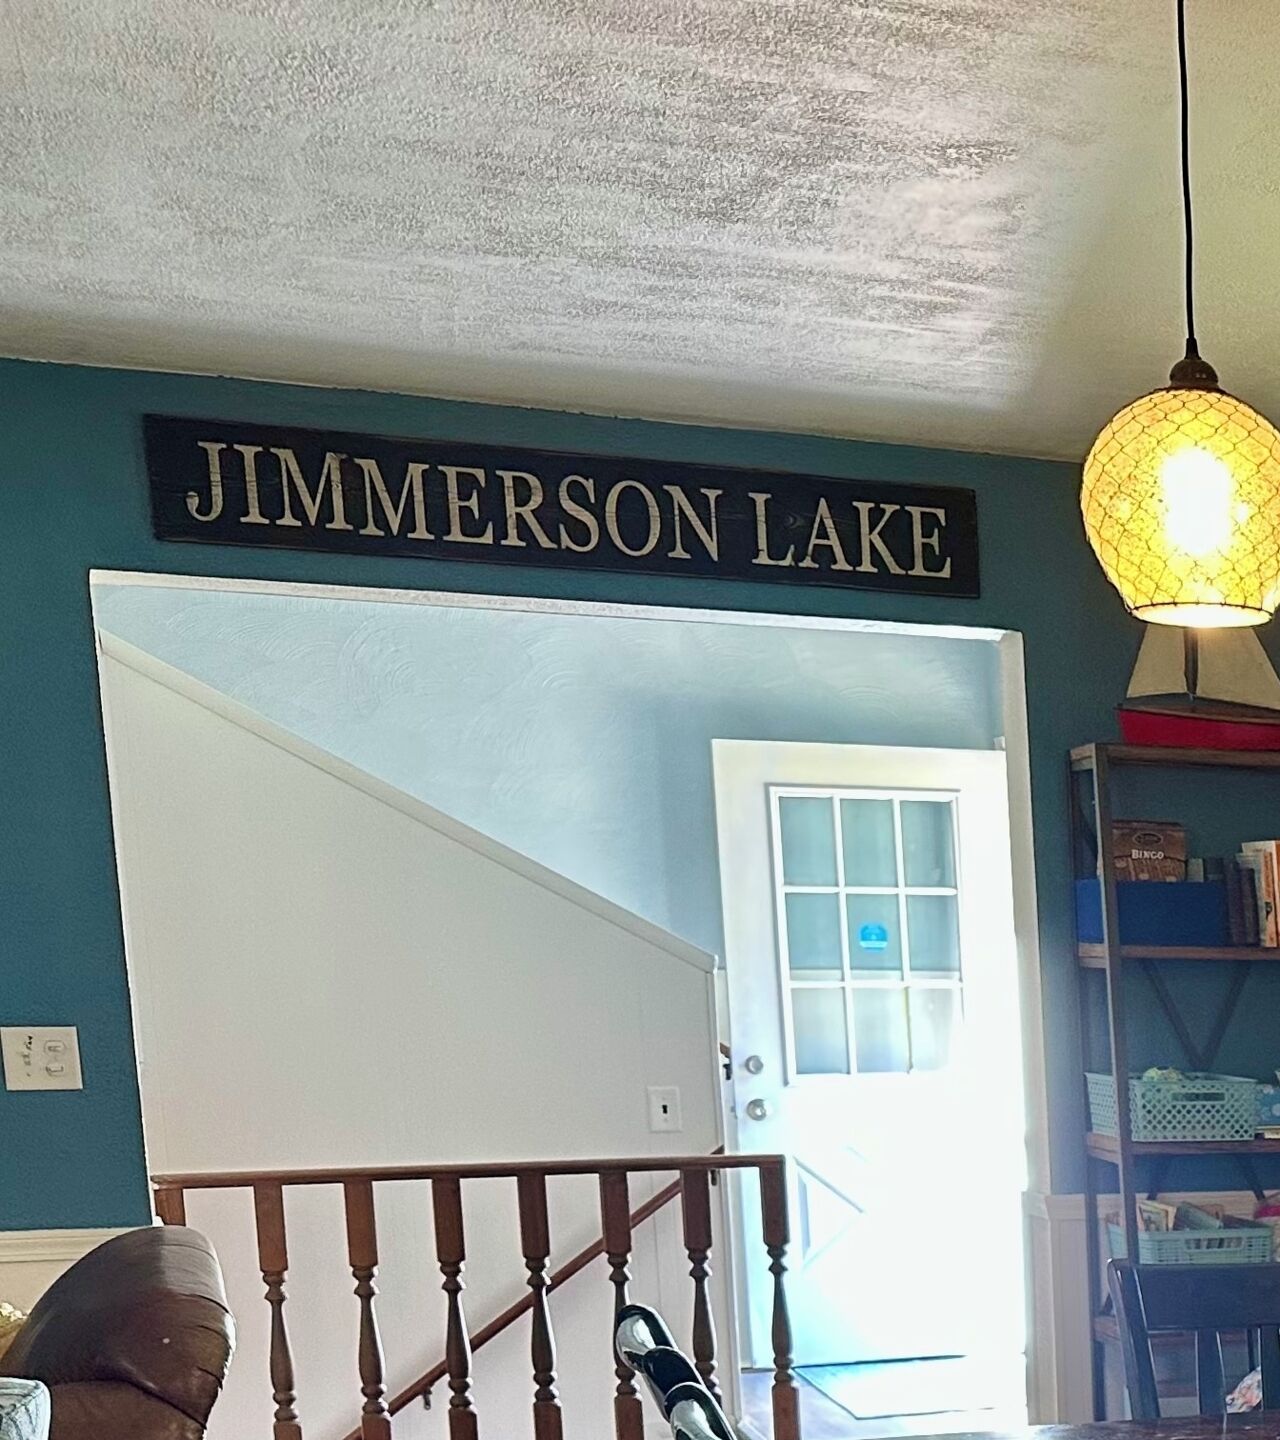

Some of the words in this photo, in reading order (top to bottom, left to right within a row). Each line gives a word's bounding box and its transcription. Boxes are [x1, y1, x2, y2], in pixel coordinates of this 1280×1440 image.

[185, 440, 724, 562] JIMMERSON
[747, 490, 954, 579] LAKE
[1131, 848, 1165, 860] BINGO
